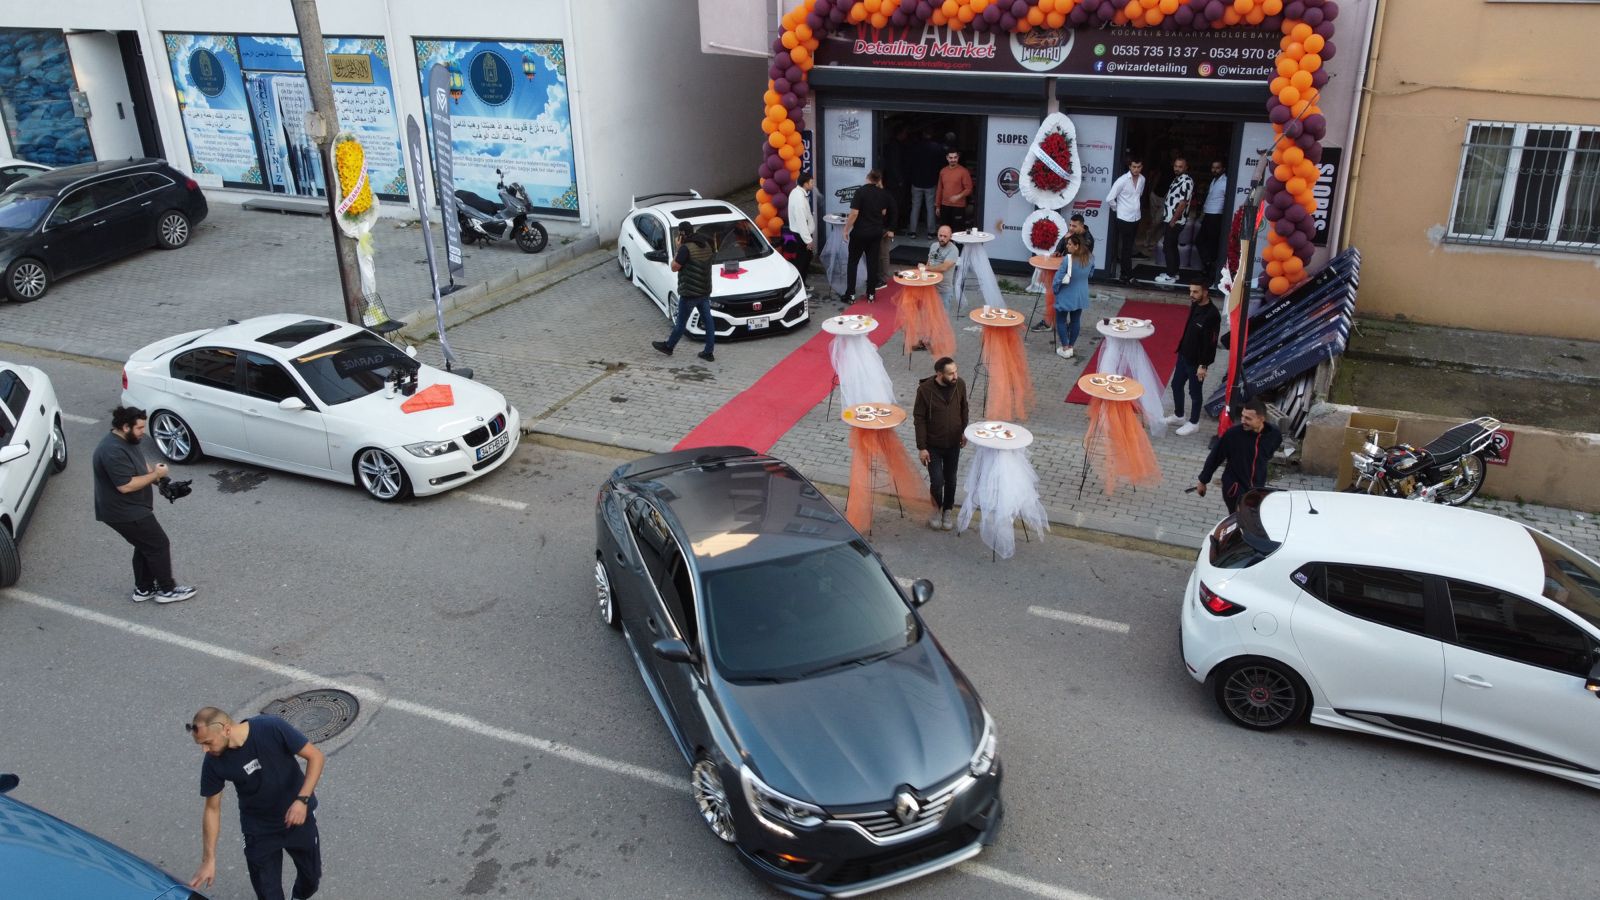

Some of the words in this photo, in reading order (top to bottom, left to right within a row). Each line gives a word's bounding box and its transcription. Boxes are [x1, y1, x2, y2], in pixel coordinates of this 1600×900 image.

[853, 39, 927, 60] Detailing
[930, 42, 996, 58] Market
[1021, 46, 1061, 63] WIZARD
[1112, 45, 1140, 57] 0535
[1143, 46, 1164, 57] 735
[1167, 47, 1181, 58] 13
[1183, 47, 1198, 58] 37
[1209, 48, 1239, 60] 0534
[1242, 48, 1264, 60] 970
[1106, 61, 1188, 75] @wizardetailing
[1217, 63, 1274, 76] @wizardet
[997, 133, 1028, 145] SLOPES
